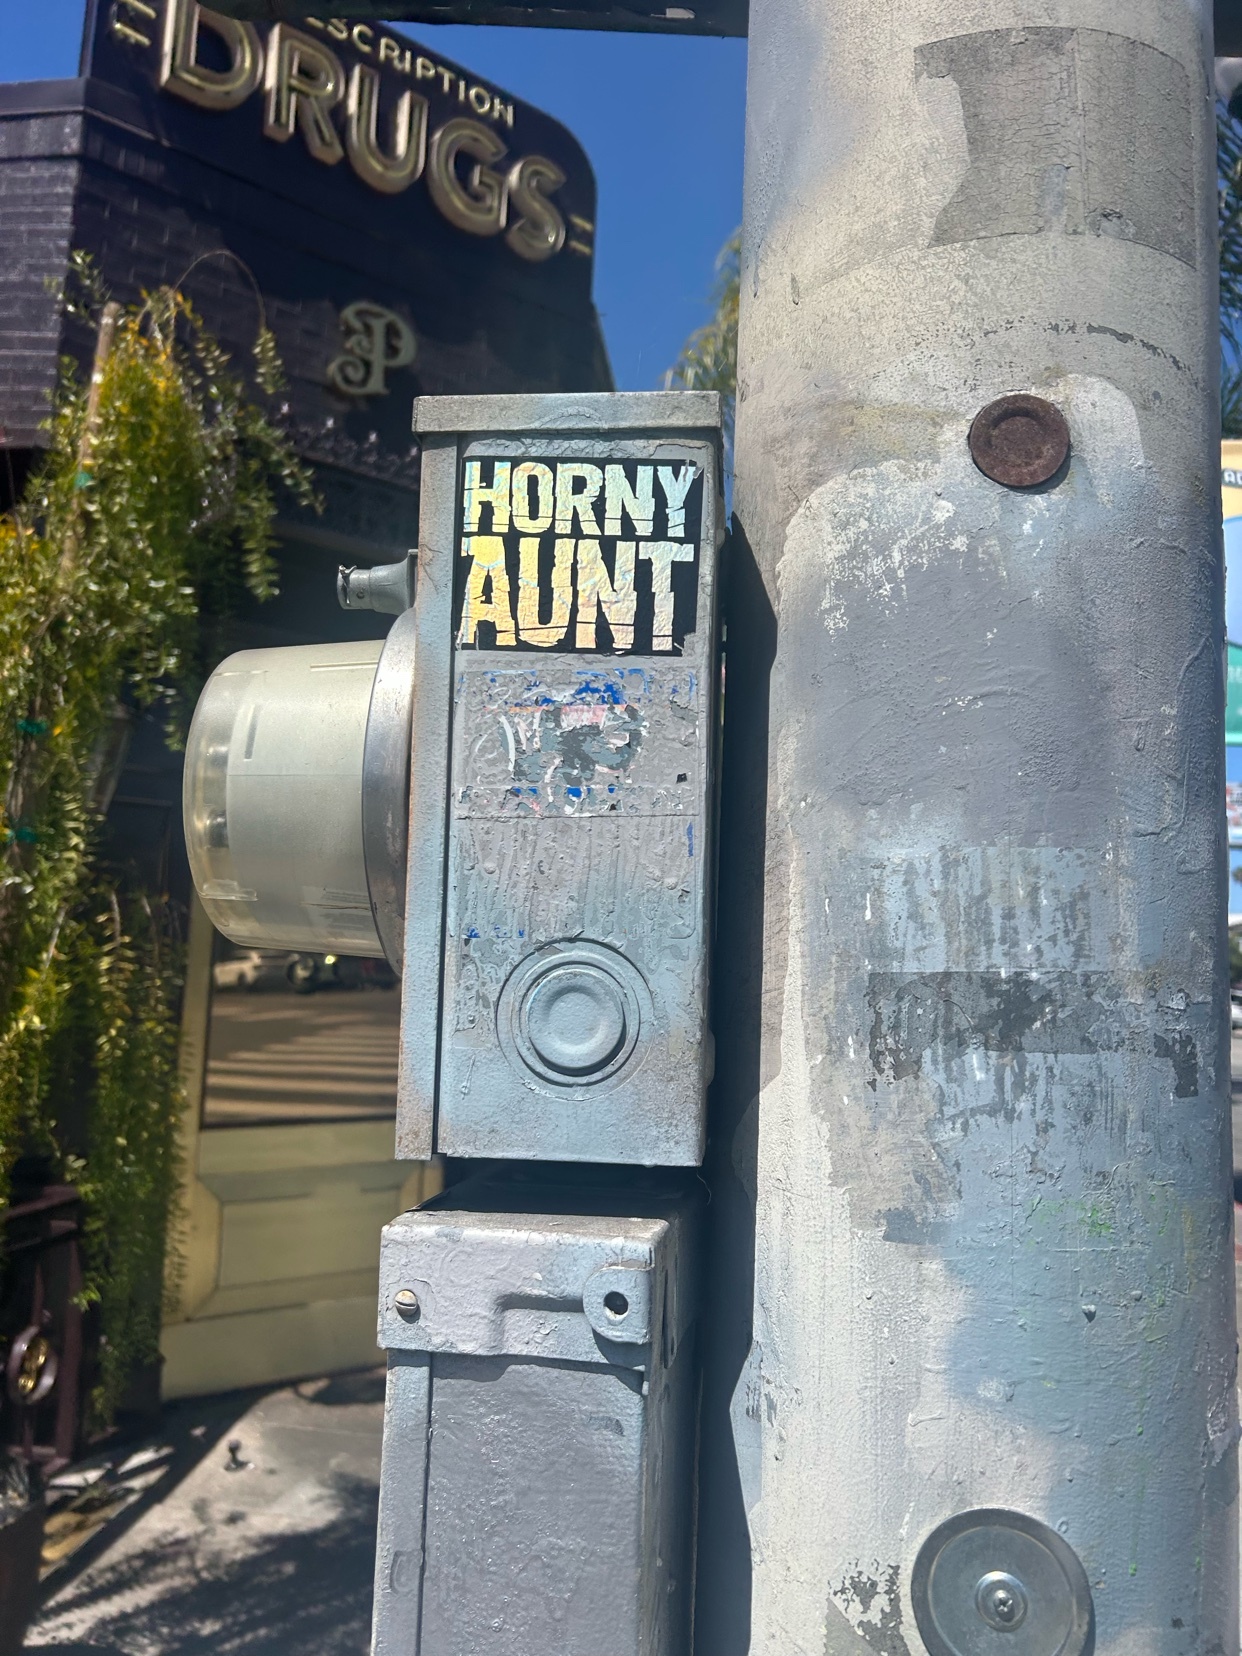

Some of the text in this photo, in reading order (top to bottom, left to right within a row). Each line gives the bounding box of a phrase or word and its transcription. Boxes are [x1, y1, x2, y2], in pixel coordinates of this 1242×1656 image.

[305, 17, 514, 128] SCRIPTION
[159, 0, 567, 262] DRUGS
[463, 460, 699, 538] HORNY
[461, 534, 695, 652] AUNT
